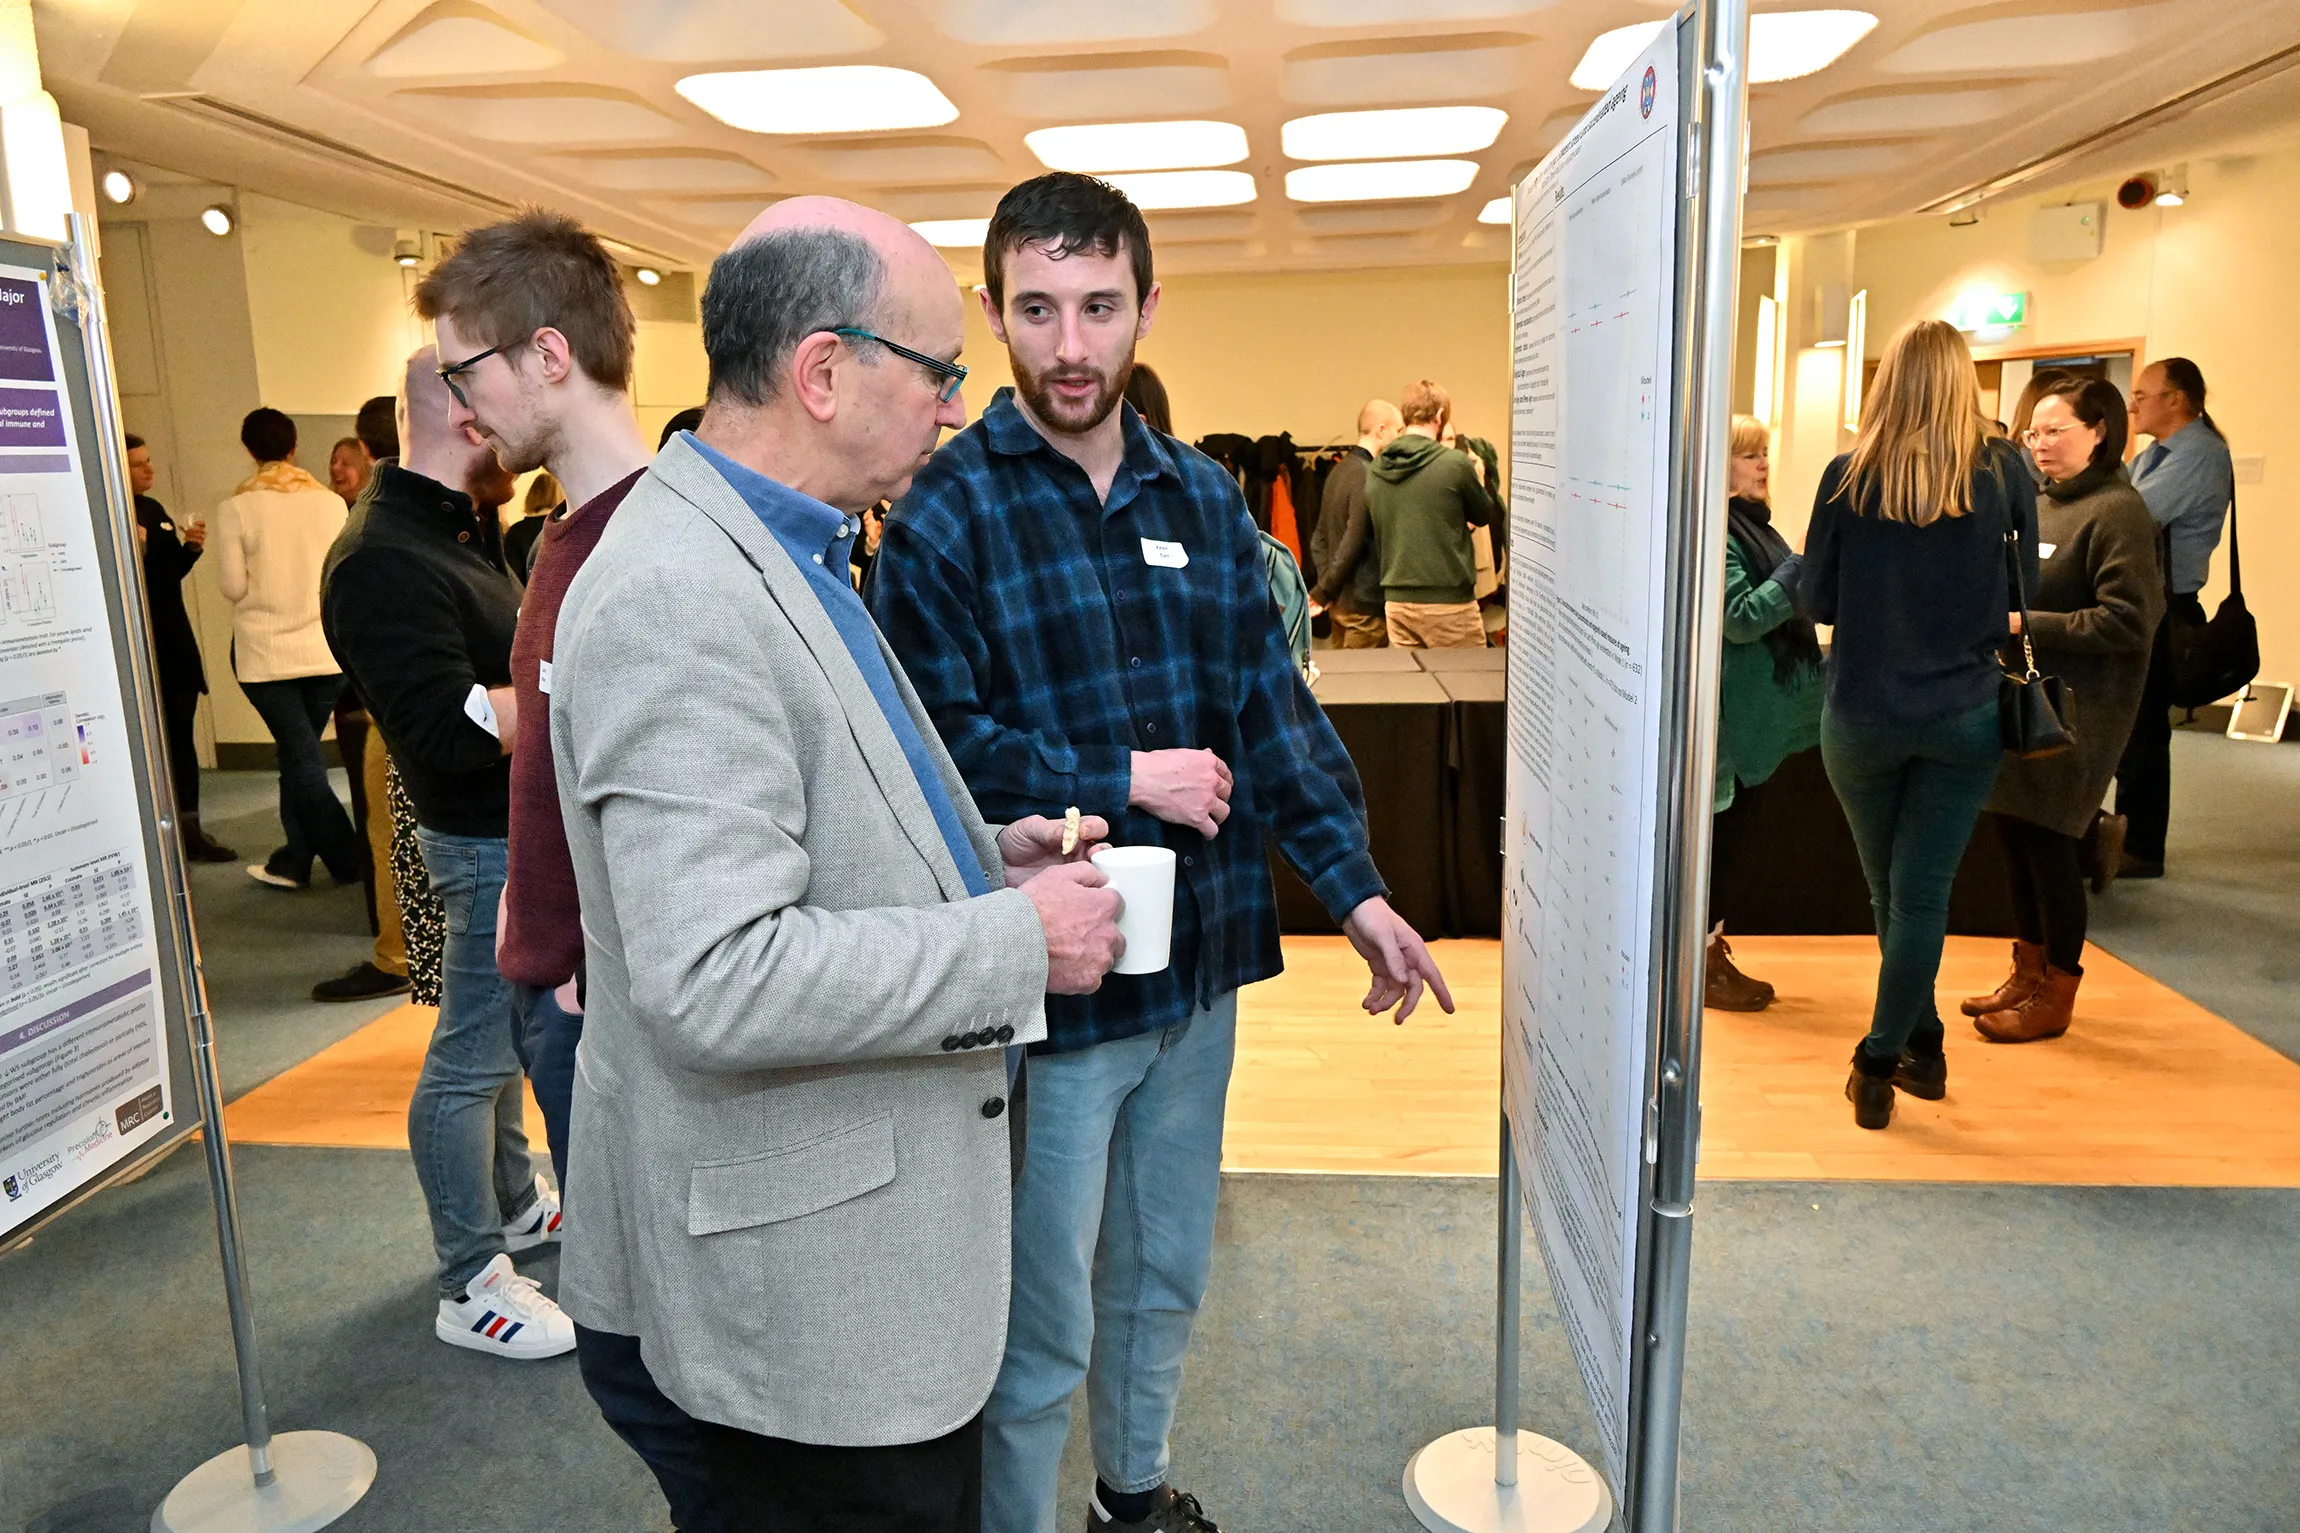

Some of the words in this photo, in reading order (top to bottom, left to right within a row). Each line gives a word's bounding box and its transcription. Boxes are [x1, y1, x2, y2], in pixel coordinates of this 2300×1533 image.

[6, 420, 31, 428] immune
[32, 420, 45, 428] and
[30, 407, 55, 418] defined
[11, 994, 21, 1002] bold
[21, 1051, 48, 1068] subgroup
[47, 1047, 58, 1056] has
[62, 1032, 85, 1048] different
[85, 1010, 130, 1036] immunometabolic
[130, 1002, 146, 1015] profile
[27, 1010, 70, 1036] DISCUSSION
[19, 1080, 34, 1091] were
[35, 1070, 51, 1083] either
[51, 1063, 63, 1074] fully
[64, 1055, 79, 1069] (total
[79, 1039, 109, 1060] cholesterol)
[115, 1027, 135, 1042] partially
[26, 1060, 54, 1076] subgroups
[54, 1048, 73, 1064] (Figure
[74, 1044, 80, 1053] 3)
[10, 1105, 26, 1117] body
[26, 1100, 34, 1108] fat
[34, 1083, 65, 1105] percentage
[65, 1077, 76, 1088] and
[76, 1062, 107, 1081] triglycerides
[113, 1051, 127, 1062] areas
[127, 1047, 133, 1055] of
[133, 1037, 151, 1050] interest
[6, 1100, 14, 1109] by
[15, 1120, 35, 1135] further
[36, 1111, 51, 1123] traits
[50, 1099, 75, 1115] including
[75, 1084, 101, 1101] hormones
[101, 1069, 125, 1088] produced
[131, 1056, 150, 1071] adipose
[15, 1135, 22, 1145] of
[22, 1125, 43, 1142] glucose
[44, 1110, 71, 1129] regulation
[72, 1103, 82, 1114] and
[120, 1112, 141, 1132] MRC
[67, 1131, 98, 1154] Precision
[84, 1131, 113, 1153] Medicine
[17, 1151, 60, 1181] University
[21, 1180, 29, 1193] of
[29, 1161, 63, 1186] Glasgow
